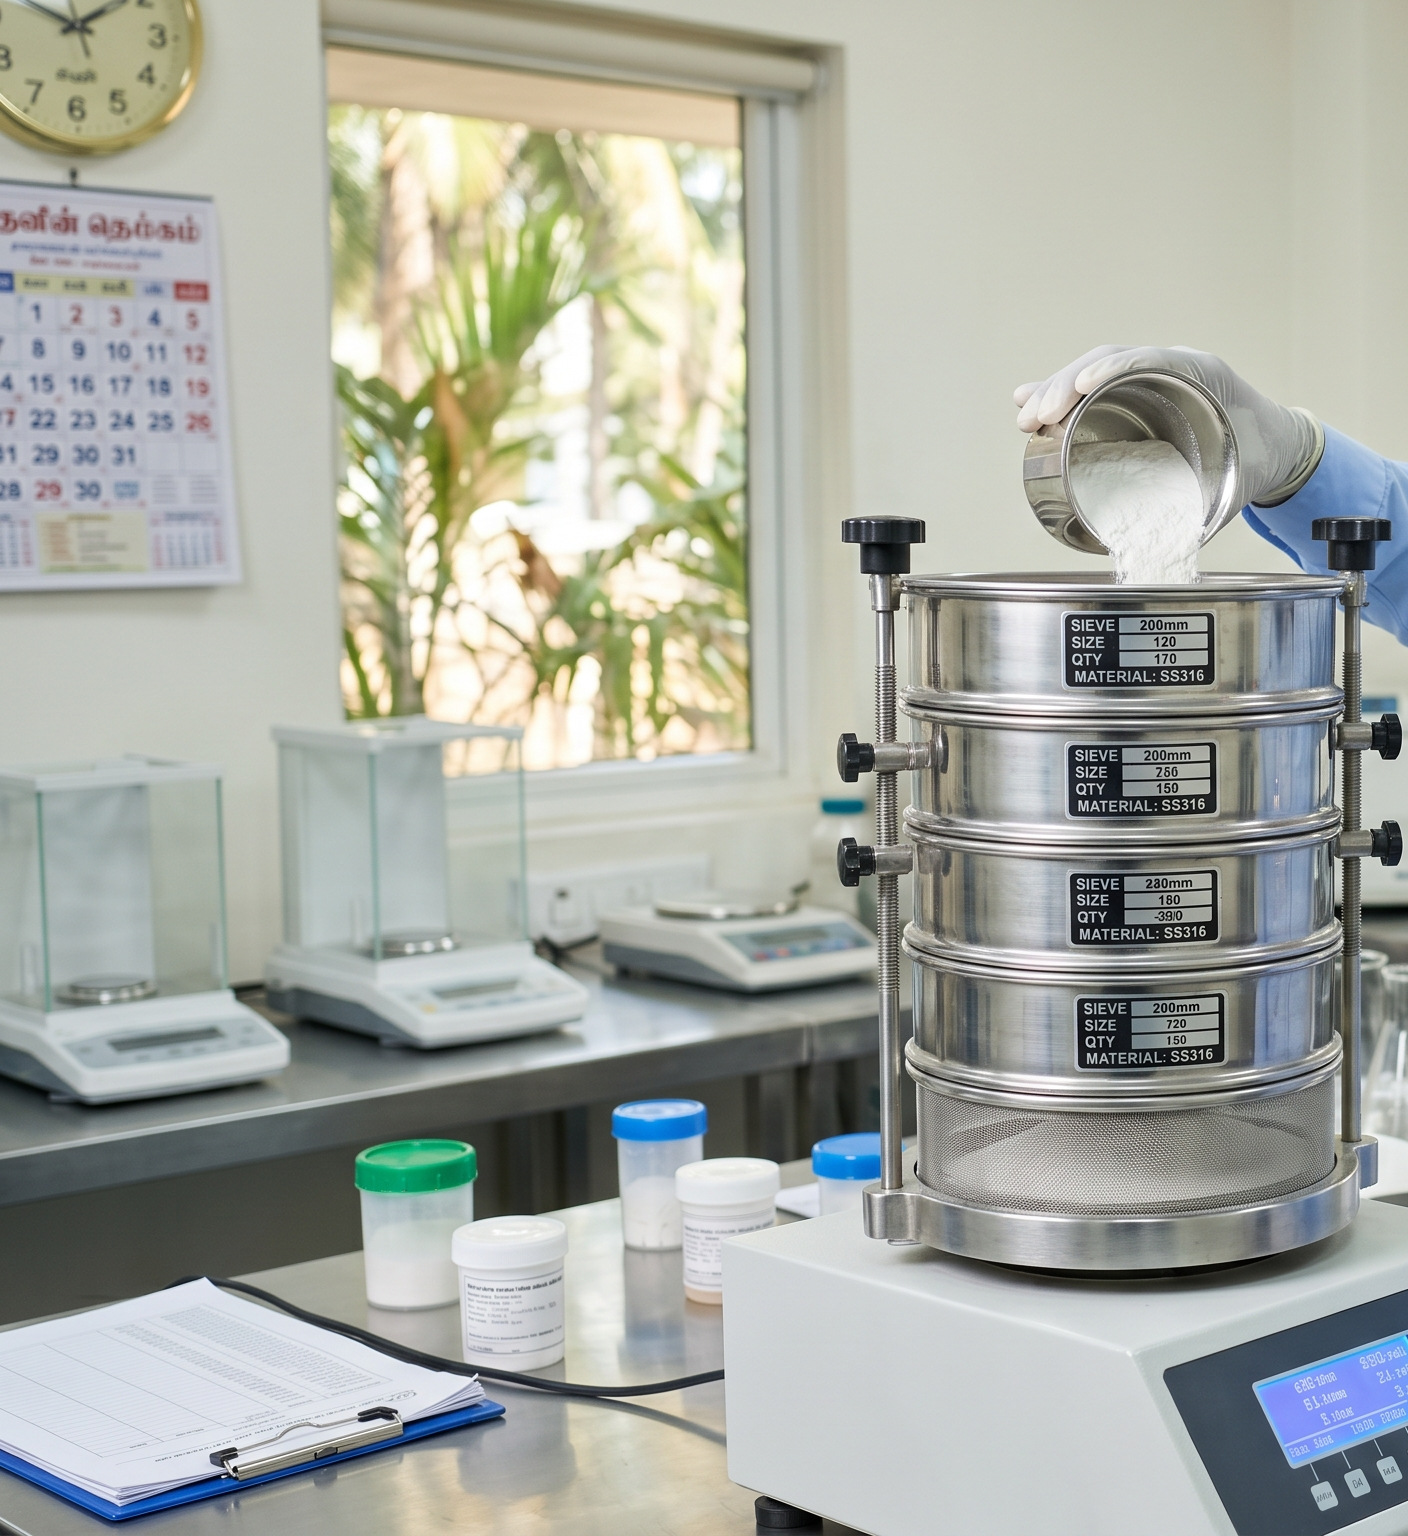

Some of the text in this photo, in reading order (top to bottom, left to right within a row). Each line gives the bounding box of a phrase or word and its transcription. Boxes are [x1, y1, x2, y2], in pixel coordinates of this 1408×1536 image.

[148, 23, 168, 50] 3
[136, 63, 157, 88] 4
[25, 78, 45, 107] 7
[67, 95, 87, 122] 6
[109, 88, 128, 116] 5
[32, 303, 200, 331] 1 2 3 4 5
[32, 338, 208, 365] 8 9 10 11 12
[29, 374, 55, 393] 15
[70, 375, 95, 394] 16
[109, 375, 133, 394] 17
[148, 377, 171, 396] 18
[186, 379, 210, 398] 19
[30, 409, 56, 430] 22
[70, 410, 97, 430] 23
[110, 411, 135, 431] 24
[148, 411, 174, 432] 25
[186, 412, 212, 432] 26
[33, 444, 60, 464] 29
[73, 445, 100, 466] 30
[113, 446, 136, 466] 31
[35, 480, 63, 501] 29
[75, 480, 102, 501] 30
[1071, 618, 1189, 632] SIEVE 200mm
[1071, 635, 1177, 649] SIZE 120
[1071, 652, 1177, 667] QTY 170
[1074, 669, 1205, 683] MATERIAL: SS316
[1074, 749, 1191, 762] SIEVE 200mm
[1075, 765, 1108, 779] SIZE
[1075, 782, 1179, 796] QTY 150
[1077, 797, 1206, 813] MATERIAL: SS316
[1076, 877, 1120, 891] SIEVE
[1076, 893, 1110, 907] SIZE
[1077, 910, 1108, 924] QTY
[1079, 925, 1207, 941] MATERIAL: SS316
[1083, 1002, 1200, 1015] SIEVE 200mm
[1084, 1018, 1187, 1032] SIZE 720
[1085, 1035, 1116, 1049] QTY
[1086, 1048, 1214, 1065] MATERIAL: SS316
